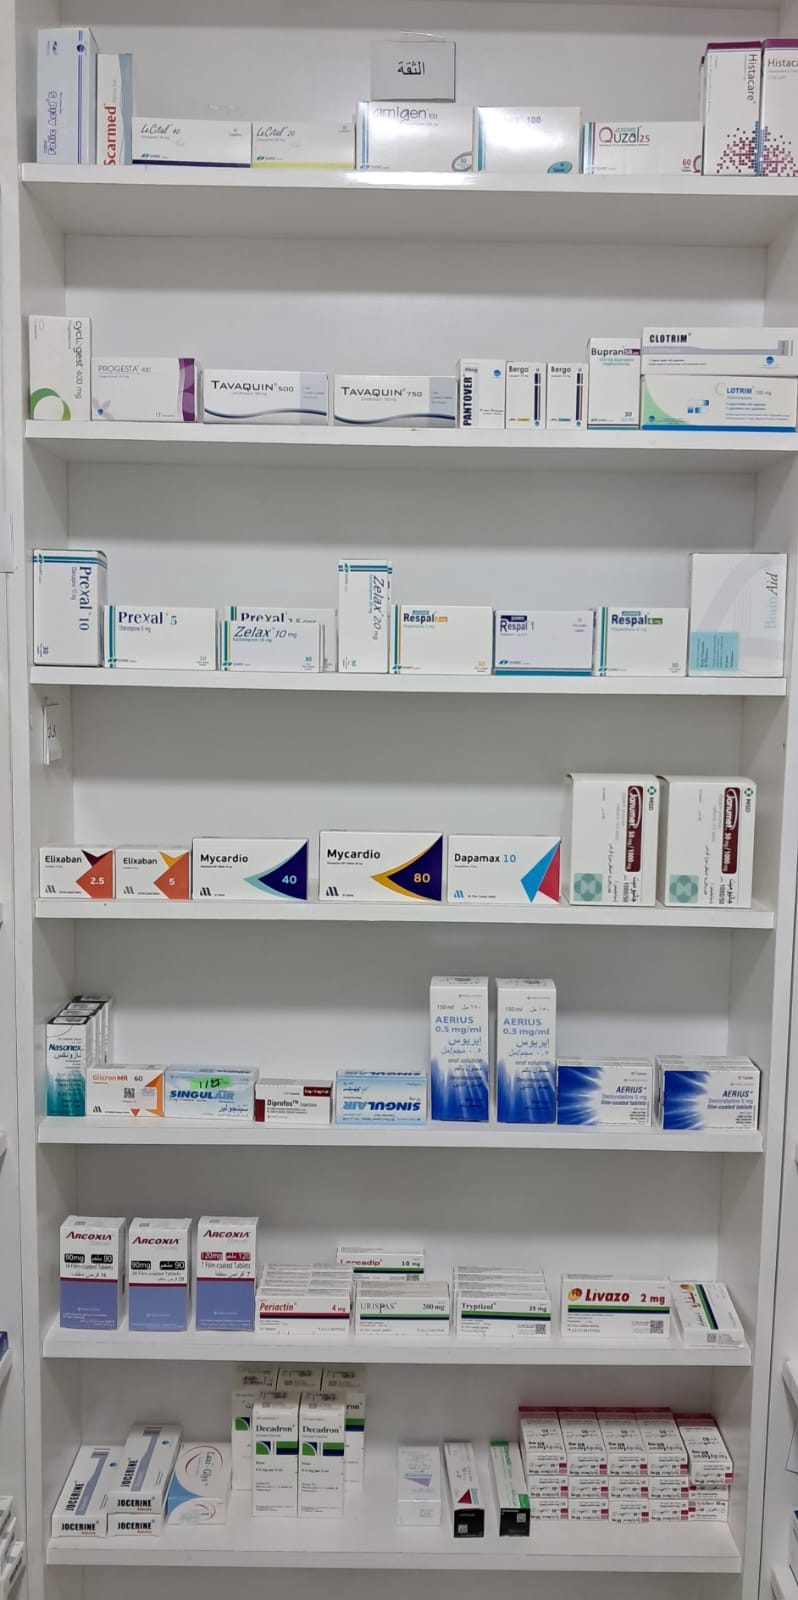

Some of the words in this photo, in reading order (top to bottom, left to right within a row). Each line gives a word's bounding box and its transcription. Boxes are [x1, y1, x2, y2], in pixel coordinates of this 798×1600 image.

[397, 61, 426, 76] الثقة
[747, 53, 758, 102] Histacare
[103, 105, 117, 166] Scarmed
[640, 134, 650, 143] 25
[682, 158, 692, 166] 60
[649, 334, 688, 343] CLOTRIM
[591, 347, 624, 357] Bupran
[98, 365, 138, 373] PROGESTA
[508, 366, 529, 375] Bergo
[550, 366, 571, 375] Bergo
[211, 380, 275, 391] TAVAQUIN
[75, 387, 82, 399] mg
[340, 386, 403, 397] TAVAQUIN
[463, 376, 473, 426] PANTOVER
[79, 566, 92, 610] Prexal
[373, 575, 385, 613] Zelax
[118, 611, 163, 625] Prexal
[170, 615, 177, 626] 5
[373, 615, 382, 631] 20
[403, 612, 435, 625] Respal
[611, 614, 647, 627] Respal
[79, 618, 90, 631] 10
[500, 620, 528, 633] Respal
[233, 625, 272, 638] Zelax
[274, 629, 287, 639] 10
[371, 632, 379, 641] mg
[628, 792, 637, 828] Janumet
[725, 793, 735, 830] Janumet
[45, 855, 82, 864] Elixaban
[200, 853, 249, 865] Mycardio
[326, 849, 381, 861] Mycardio
[454, 853, 500, 864] Dapamax
[503, 854, 517, 863] 10
[123, 857, 158, 865] Elixaban
[90, 877, 105, 885] 2.5
[168, 878, 176, 886] 5
[282, 874, 297, 885] 40
[413, 873, 431, 883] 80
[435, 1016, 474, 1024] AERIUS
[503, 1018, 542, 1026] AERIUS
[451, 1026, 482, 1034] mg/ml
[519, 1028, 550, 1036] mg/ml
[170, 1090, 235, 1100] SINGULAIR
[722, 1090, 750, 1098] AERIUS
[343, 1101, 421, 1111] SINGULAIR
[65, 1231, 112, 1241] ARCOXIA
[203, 1229, 250, 1238] ARCOXIA
[131, 1236, 180, 1245] ARCOXIA
[174, 1261, 185, 1269] 90
[585, 1288, 630, 1302] Livazo
[640, 1294, 646, 1302] 2
[650, 1294, 665, 1305] mg
[260, 1302, 294, 1311] Periactin
[461, 1302, 493, 1310] Tryptizol
[256, 1424, 293, 1433] Decadron
[302, 1425, 339, 1434] Decadron
[117, 1498, 152, 1507] JOCERINE
[62, 1522, 96, 1531] JOCERINE
[117, 1521, 152, 1530] JOCERINE
